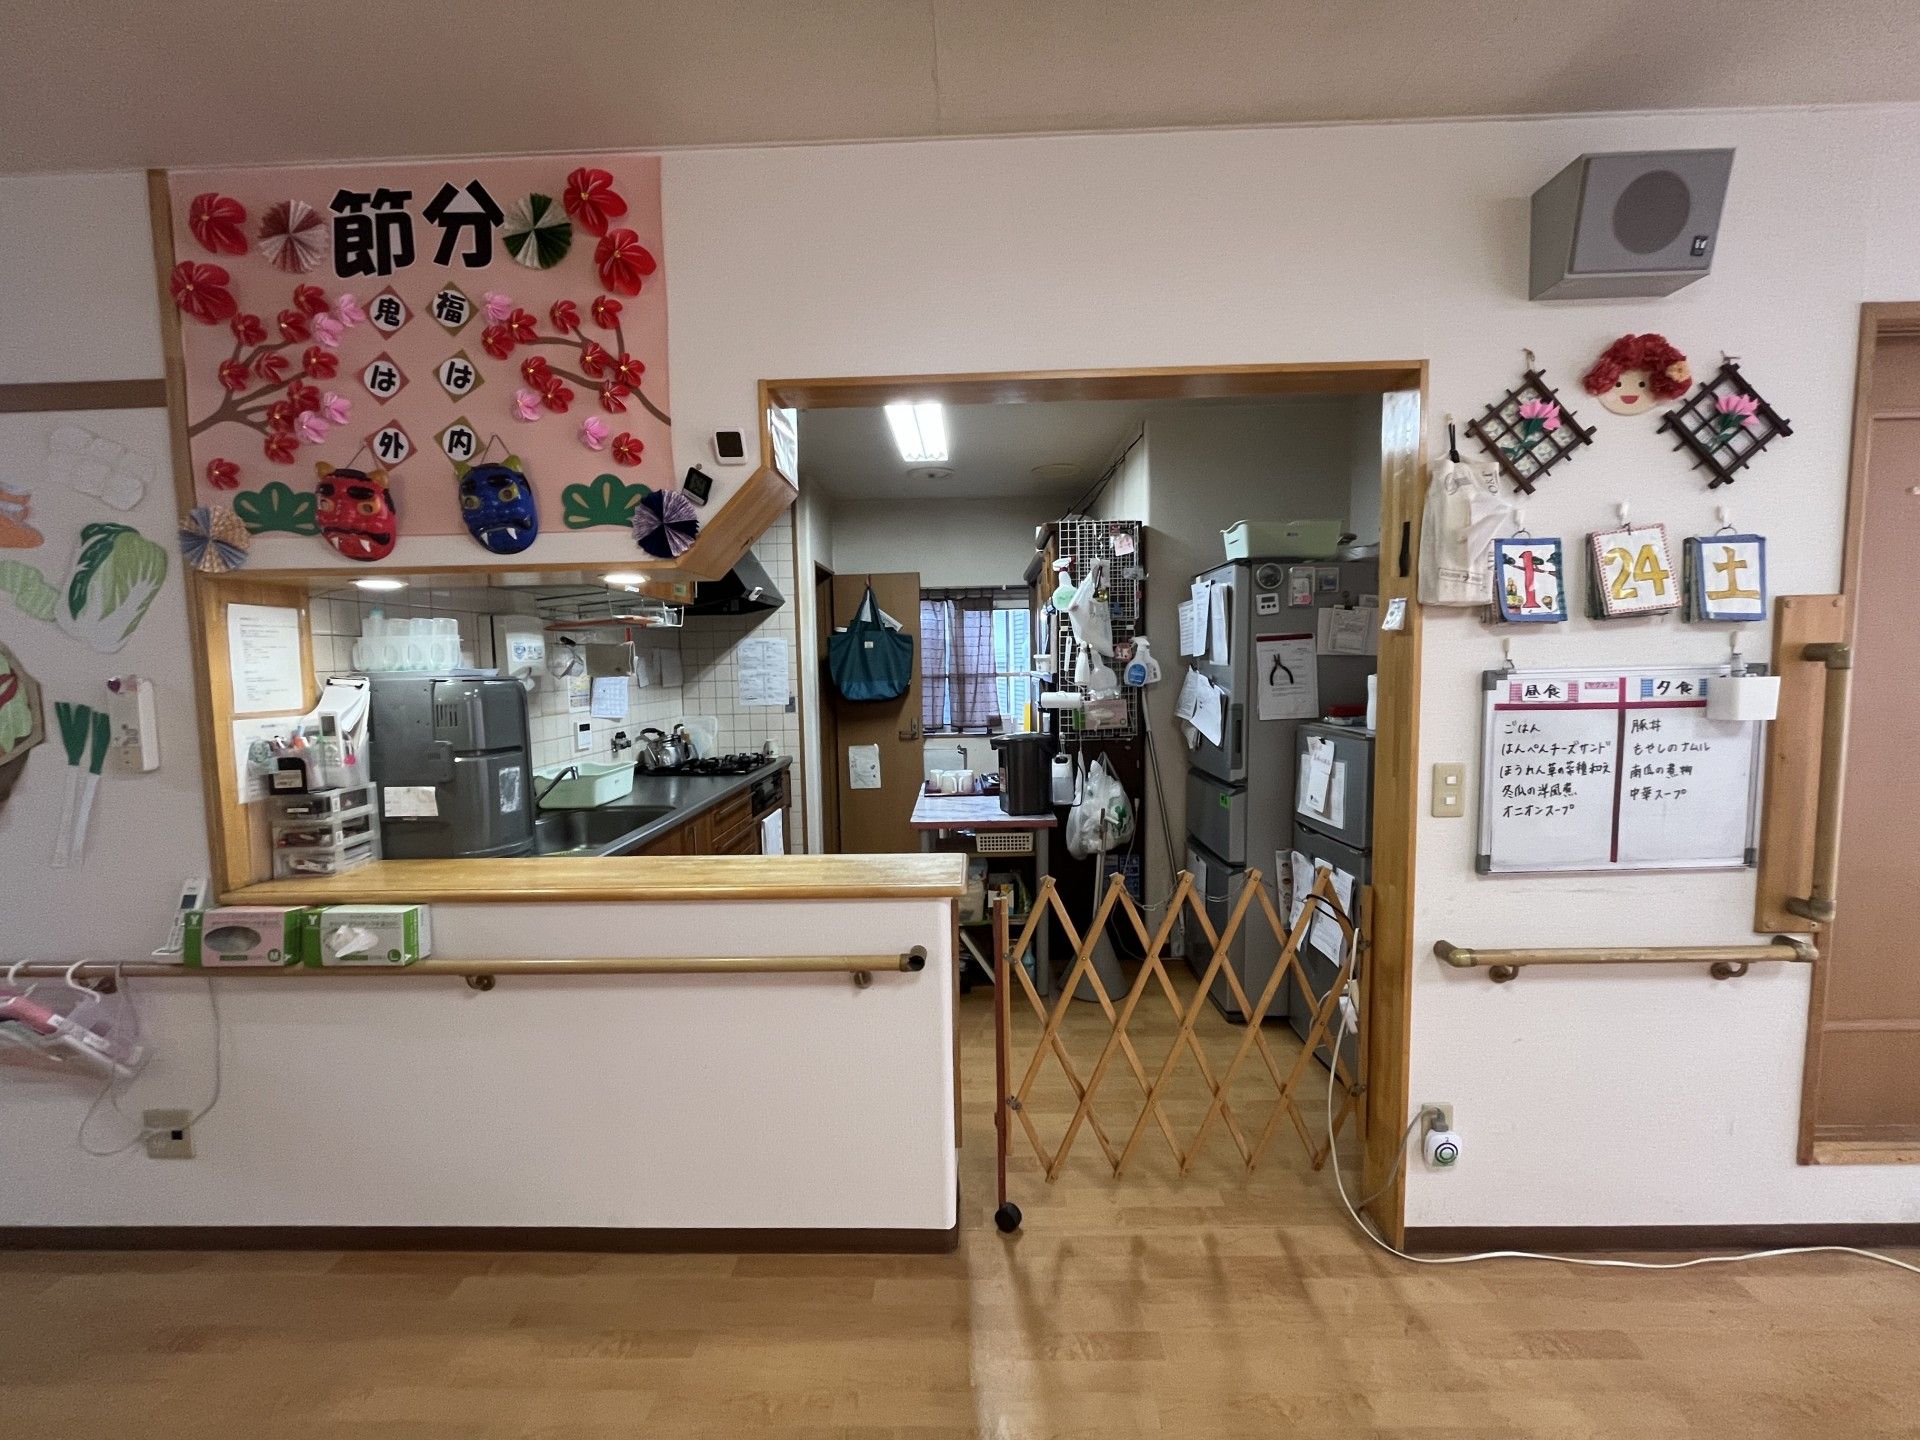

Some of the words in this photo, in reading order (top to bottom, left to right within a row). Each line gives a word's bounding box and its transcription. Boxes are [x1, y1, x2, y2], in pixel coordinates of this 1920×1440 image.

[329, 179, 505, 279] 節分
[369, 297, 405, 459] 鬼は外
[436, 291, 473, 456] 福は内
[1603, 544, 1670, 600] 24
[1706, 545, 1761, 600] 土
[1524, 684, 1561, 698] 昼食
[1656, 680, 1694, 695] 夕食
[1504, 720, 1541, 735] ごはん
[1501, 741, 1611, 756] はんぺんチーズサンド
[1633, 742, 1711, 756] もやしのナムル
[1629, 786, 1687, 801] 中華スープ
[1502, 804, 1575, 818] オニオンスープ
